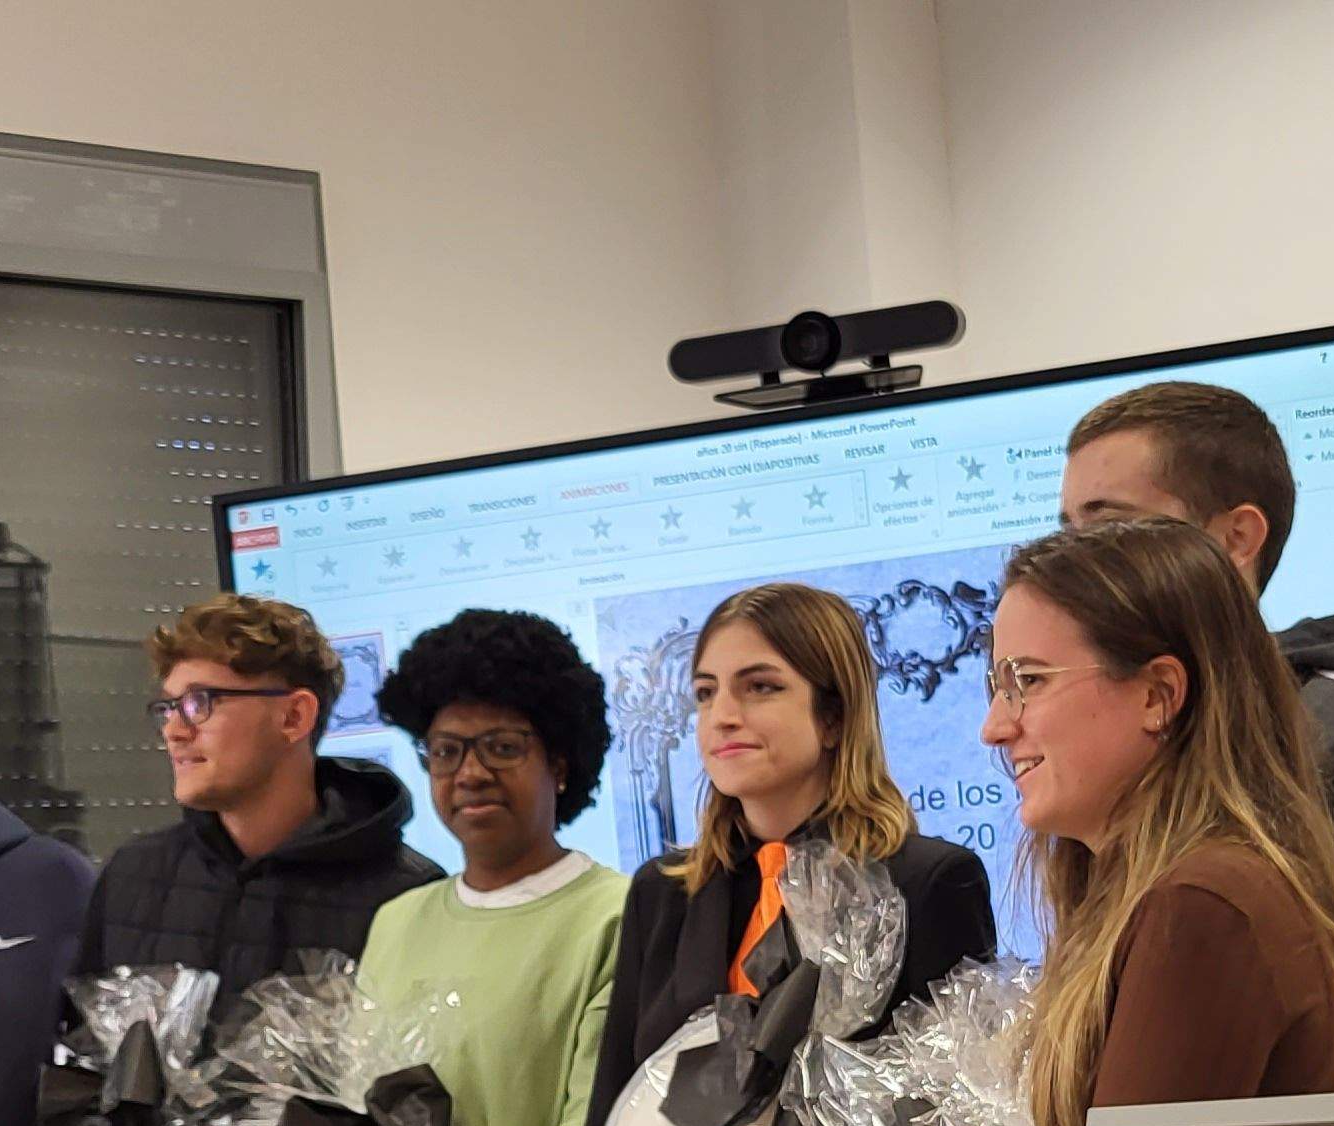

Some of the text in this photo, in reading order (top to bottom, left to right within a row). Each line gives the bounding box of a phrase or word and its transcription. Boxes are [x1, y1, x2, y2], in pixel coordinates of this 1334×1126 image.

[811, 425, 858, 441] Microsoft
[859, 416, 916, 434] PowerPoint
[843, 444, 886, 460] REVISAR
[909, 436, 939, 450] VISTA
[652, 461, 727, 487] PRESENTACIÓN
[728, 460, 752, 477] CON
[907, 780, 1003, 812] de los
[957, 823, 996, 851] 20
